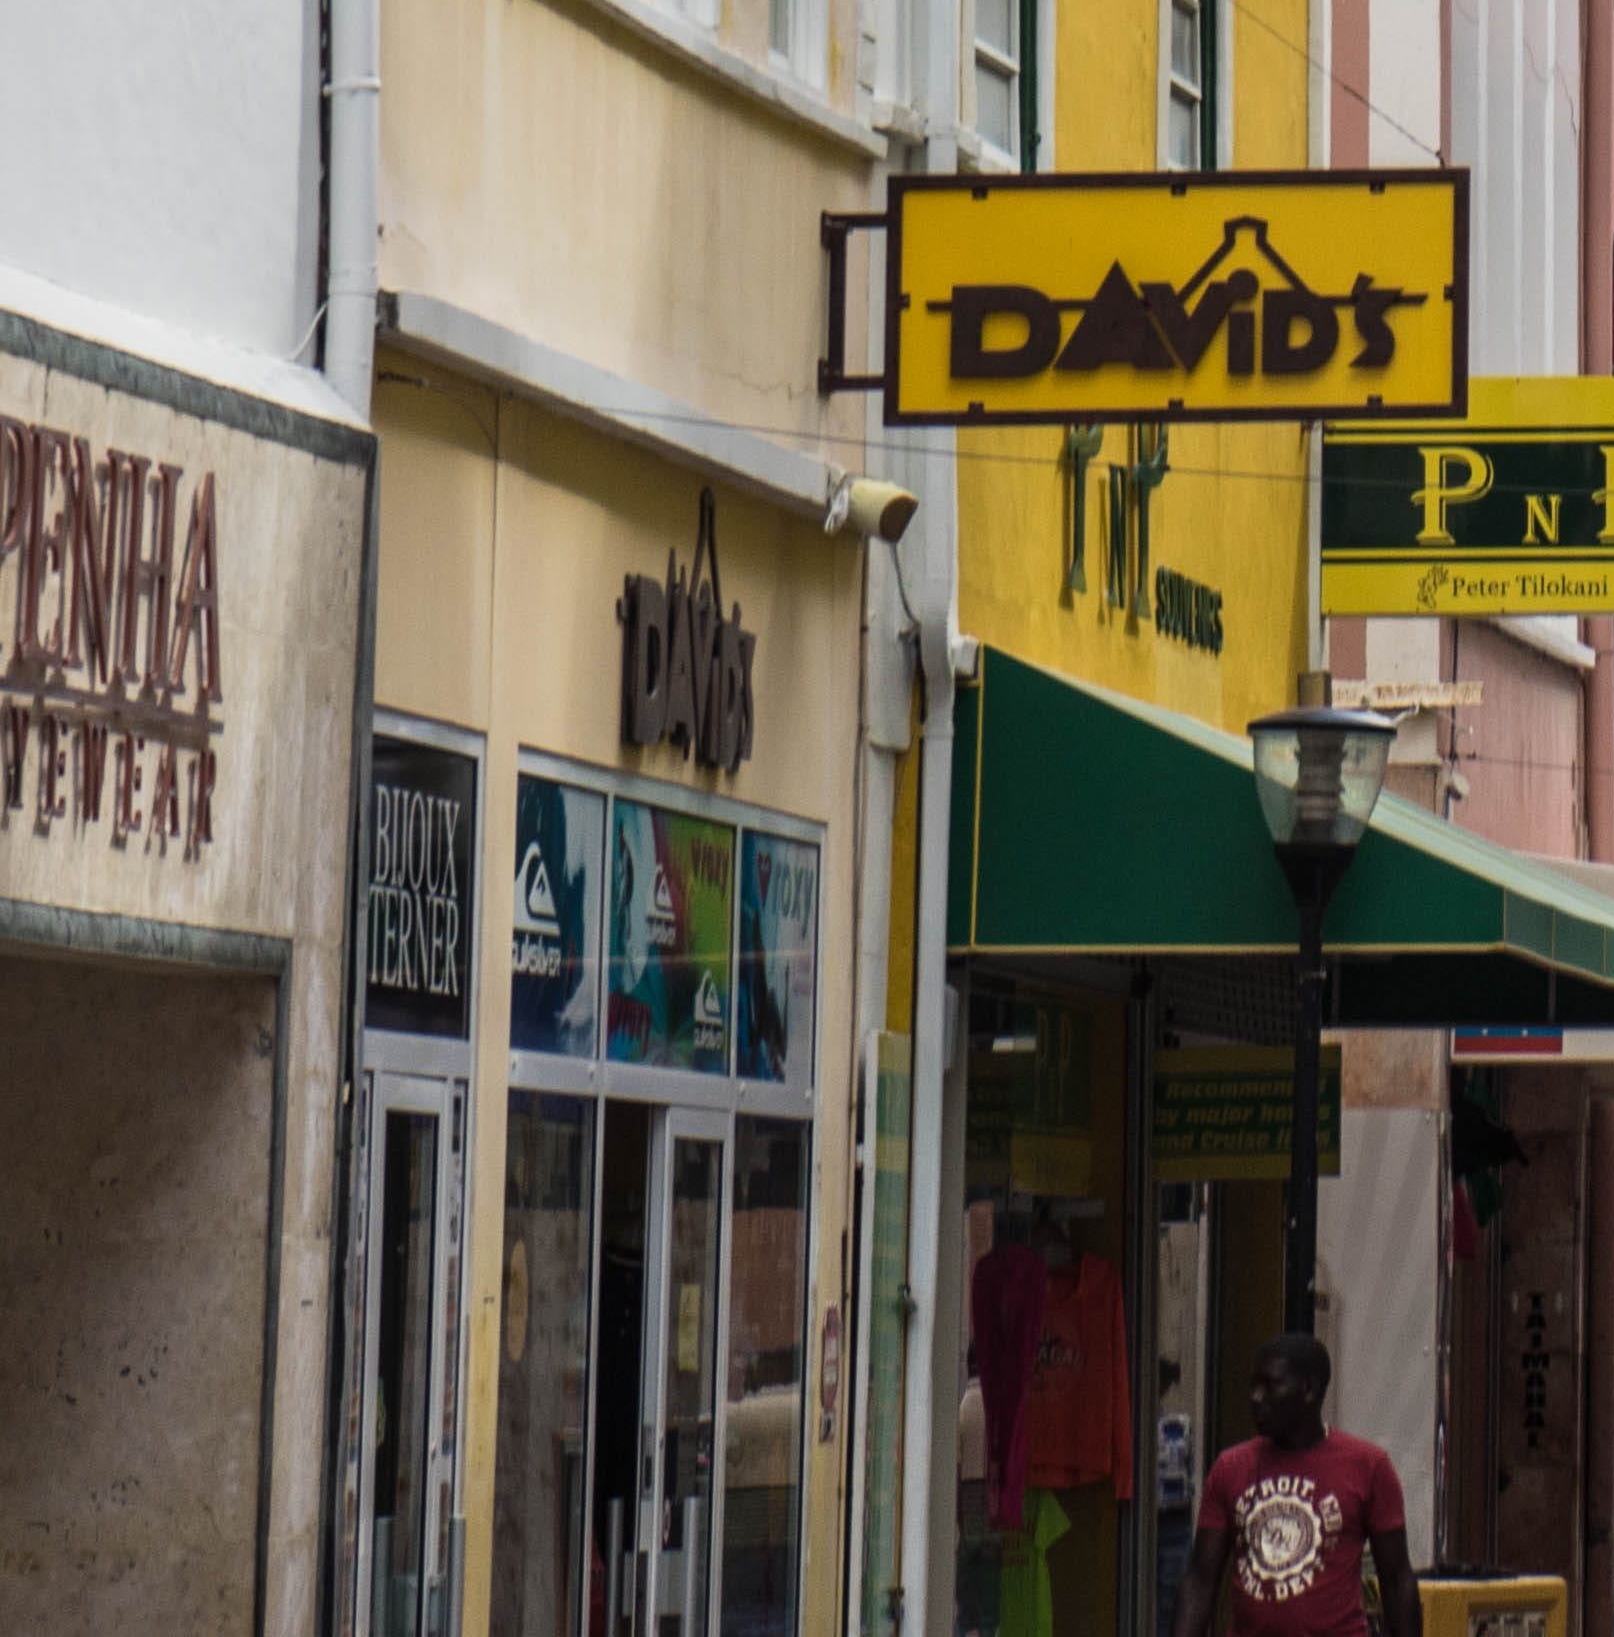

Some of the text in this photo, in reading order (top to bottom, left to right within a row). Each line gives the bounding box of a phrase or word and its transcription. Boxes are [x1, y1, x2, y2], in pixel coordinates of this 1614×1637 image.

[1451, 575, 1510, 598] Peter
[1516, 572, 1609, 598] Tilokani
[374, 783, 461, 899] BIJOUX
[368, 883, 460, 998] TERNER
